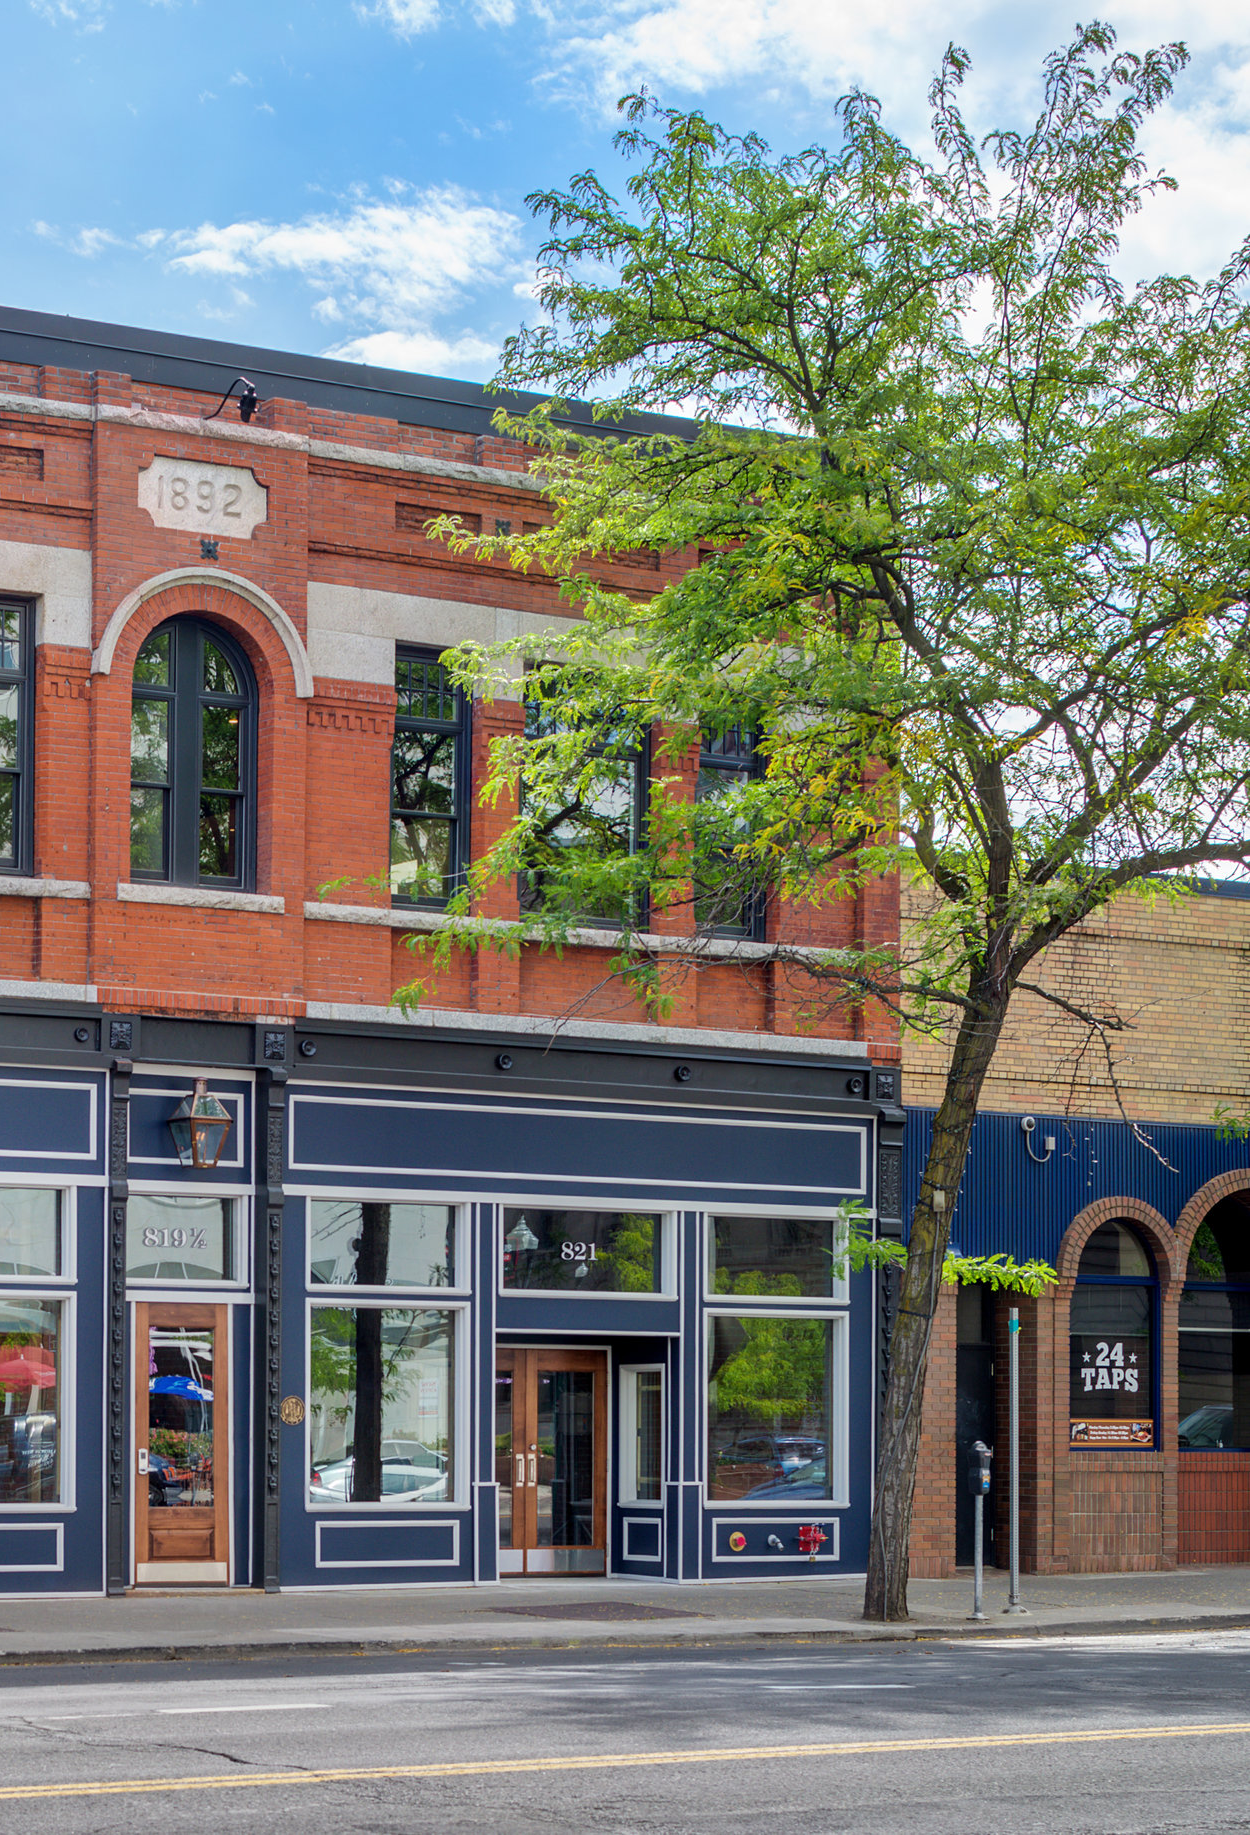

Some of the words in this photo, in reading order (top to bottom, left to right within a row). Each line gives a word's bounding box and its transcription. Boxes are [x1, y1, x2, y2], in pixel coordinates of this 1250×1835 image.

[158, 475, 242, 519] 1892
[561, 1241, 598, 1261] 821
[1096, 1341, 1125, 1367] 24
[1081, 1368, 1139, 1393] TAPS
